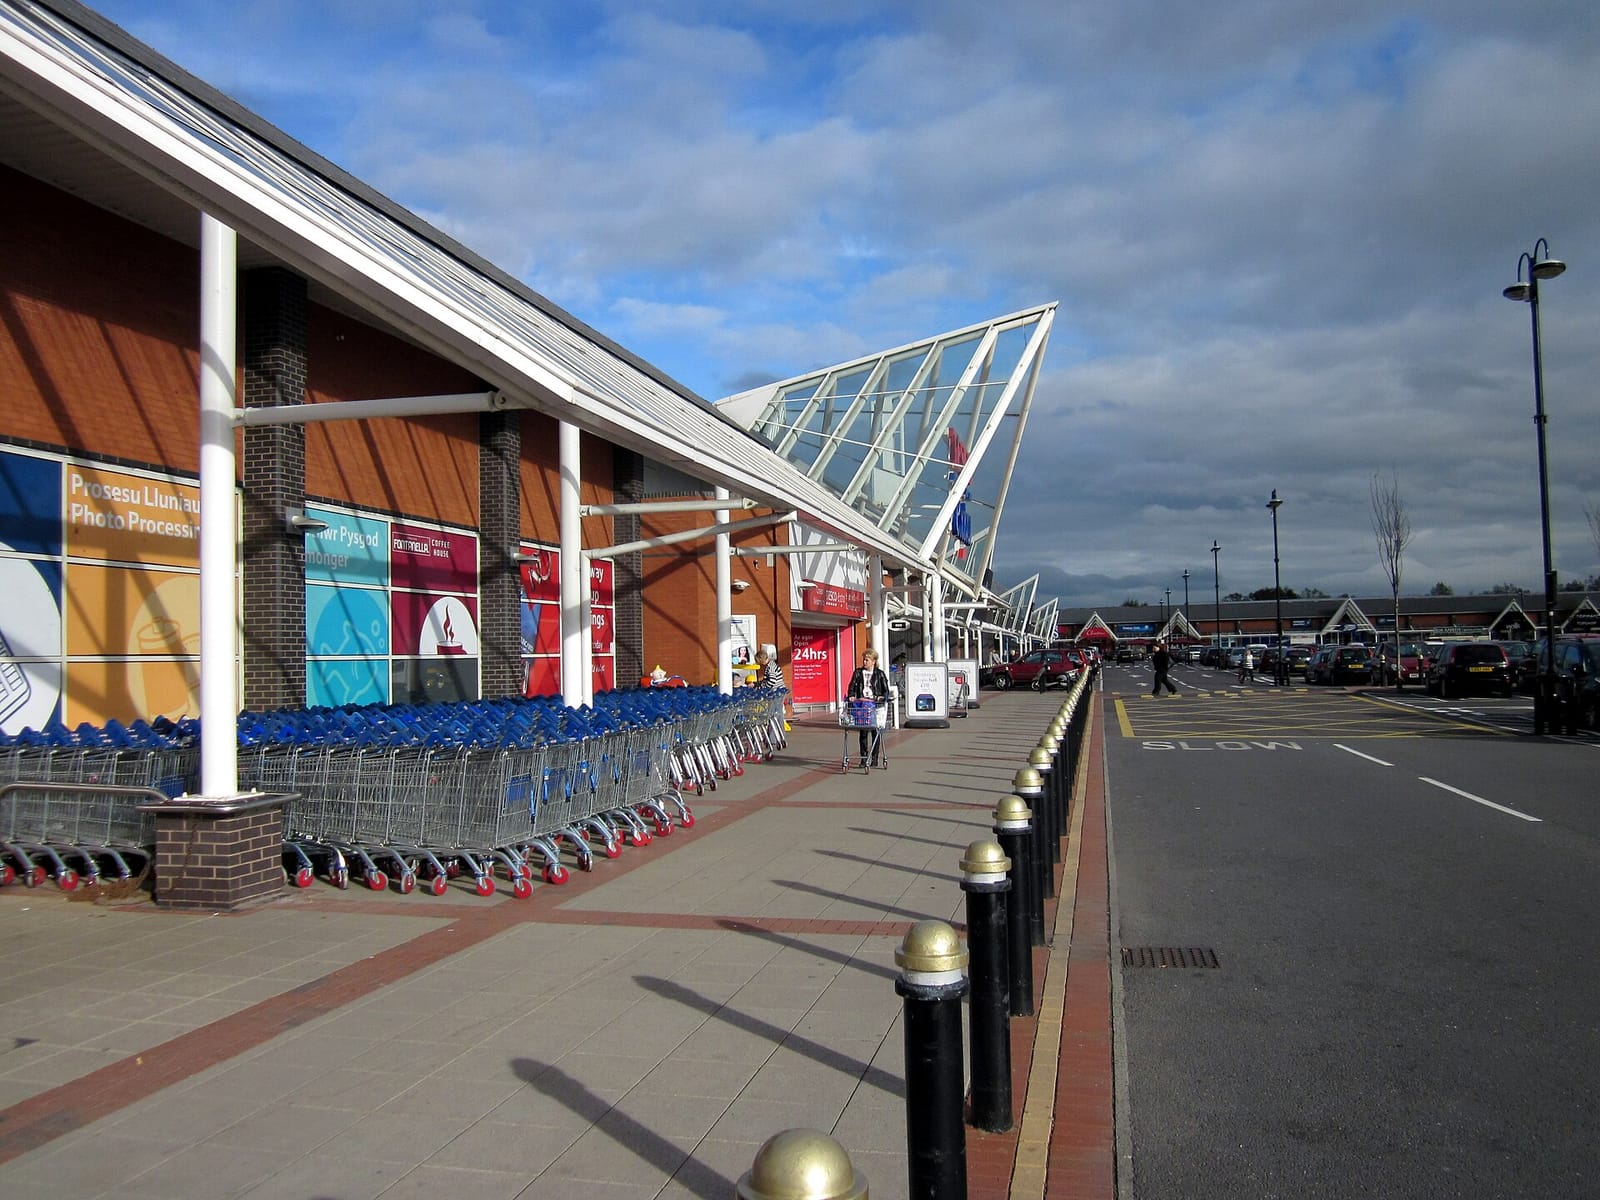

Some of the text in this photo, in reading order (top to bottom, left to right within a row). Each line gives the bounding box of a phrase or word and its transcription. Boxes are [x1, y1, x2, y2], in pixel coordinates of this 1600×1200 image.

[71, 473, 200, 514] Prosesu Lluniau
[71, 503, 125, 530] Photo
[340, 525, 379, 549] Pysgod
[431, 539, 451, 549] COFFEE
[794, 647, 827, 660] 24hrs
[1141, 741, 1303, 751] SLOW
